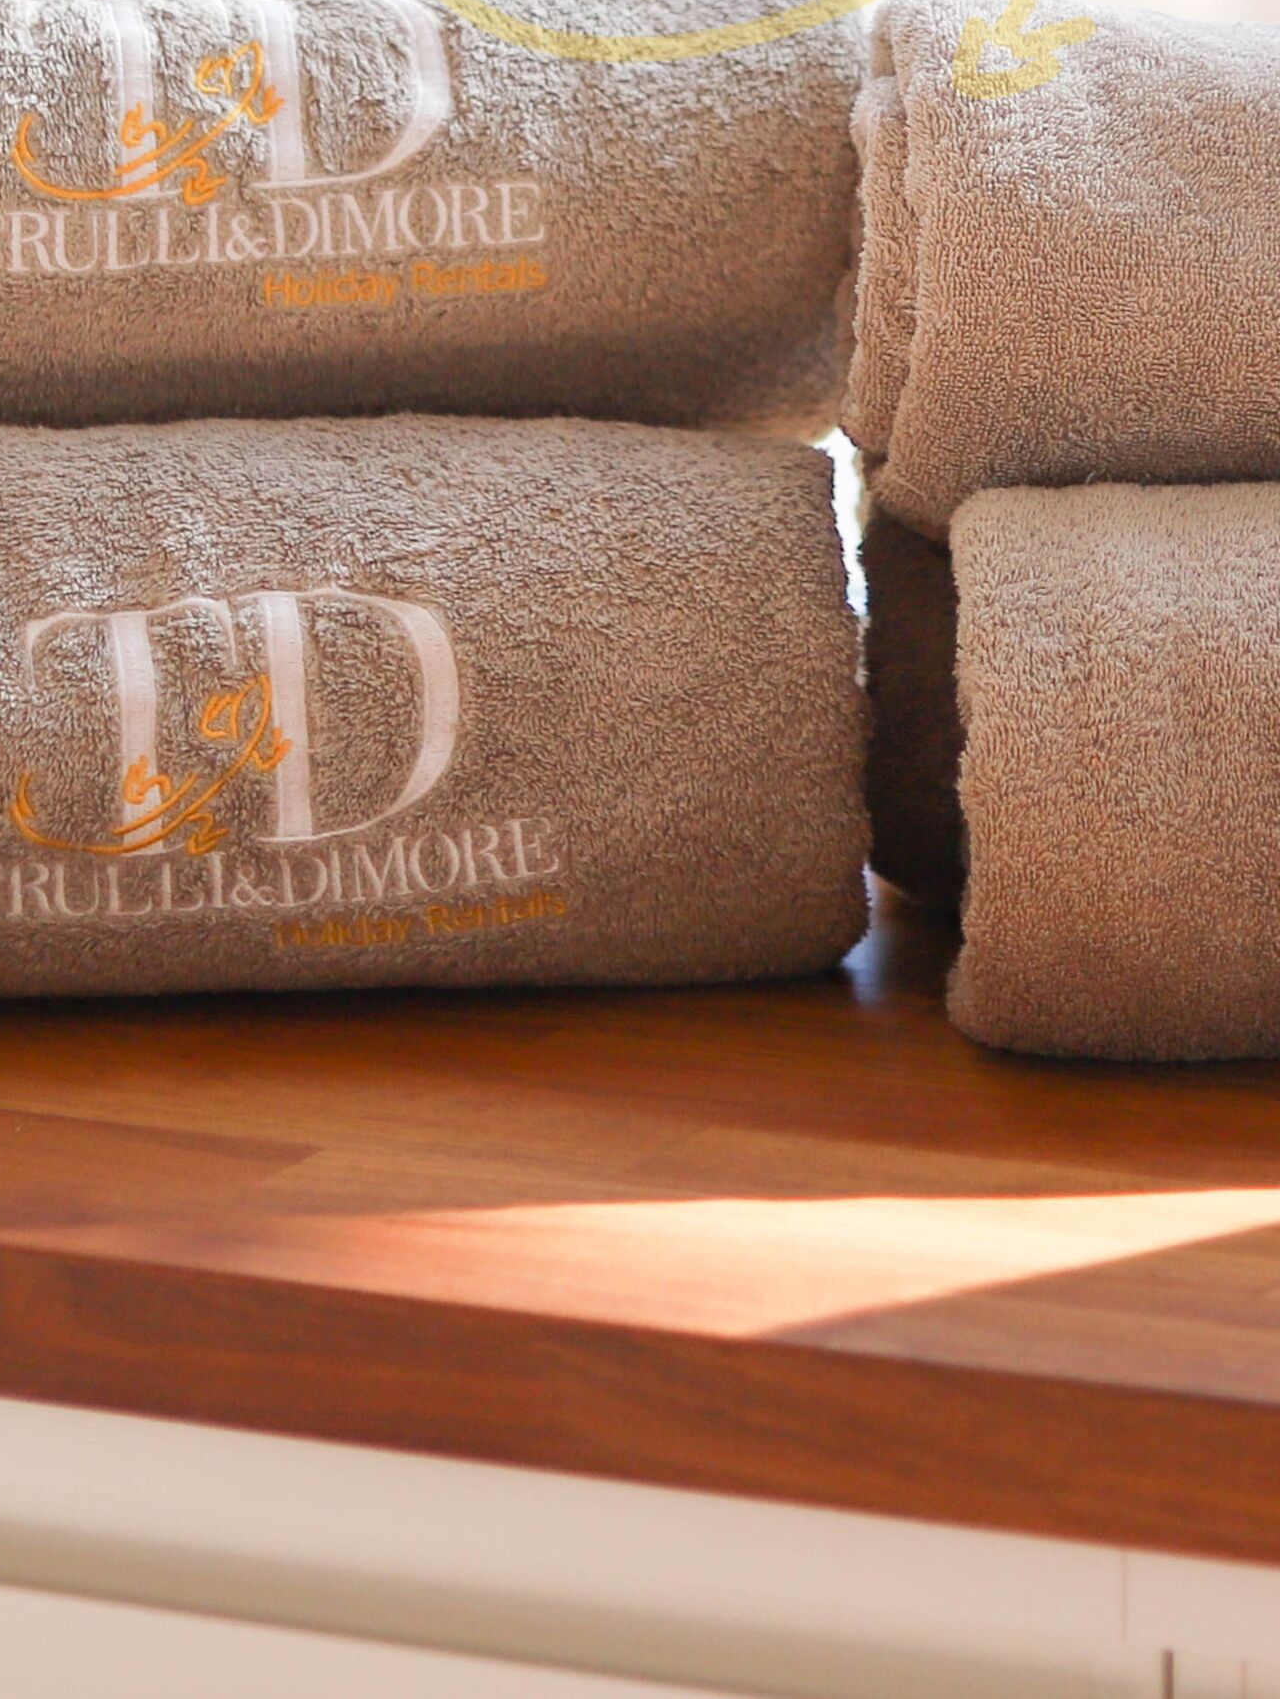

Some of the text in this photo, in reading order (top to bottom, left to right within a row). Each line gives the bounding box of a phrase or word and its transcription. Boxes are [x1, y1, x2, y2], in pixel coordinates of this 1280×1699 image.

[265, 254, 548, 307] Holiday Rentals
[26, 586, 459, 857] TD
[425, 889, 567, 935] Rentals
